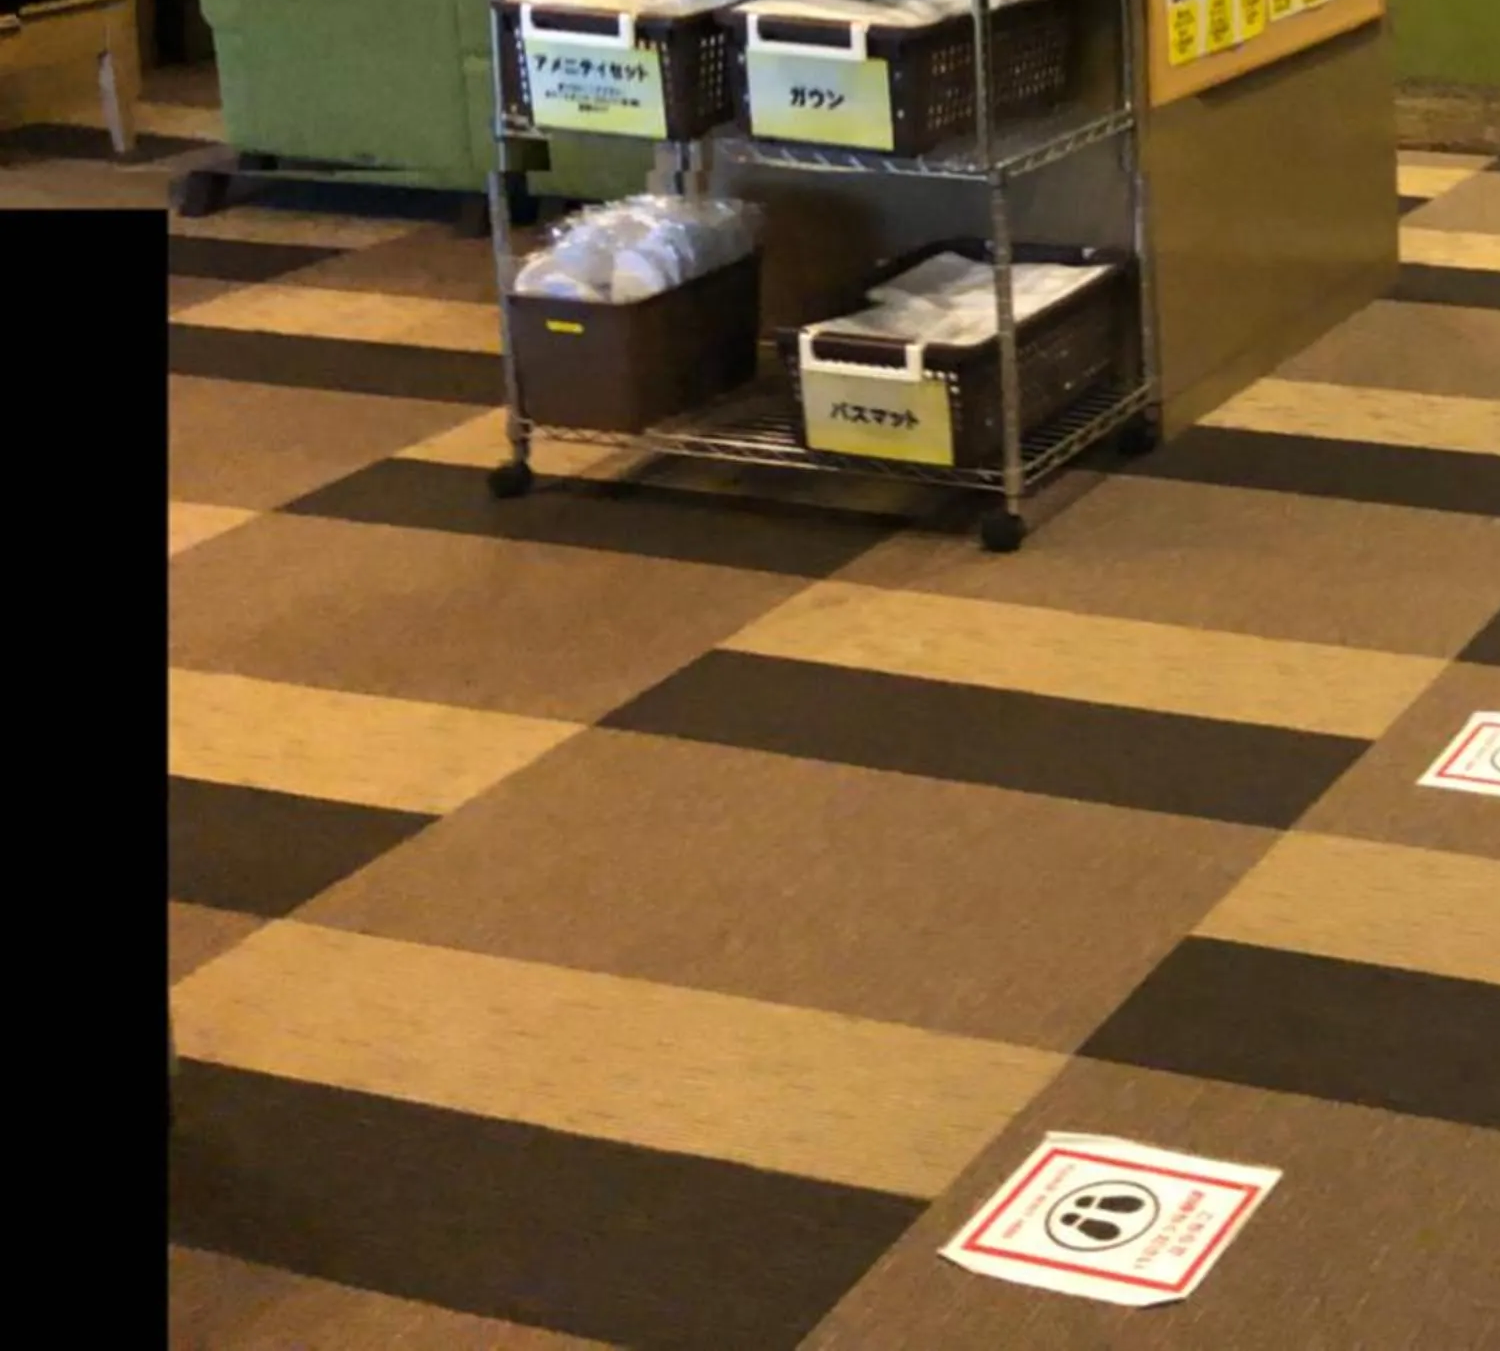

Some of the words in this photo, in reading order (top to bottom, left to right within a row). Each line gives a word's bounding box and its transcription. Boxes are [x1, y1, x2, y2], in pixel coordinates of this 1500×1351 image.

[534, 54, 648, 82] アメニティセット
[789, 86, 844, 110] ガウン
[830, 402, 919, 430] バスマット
